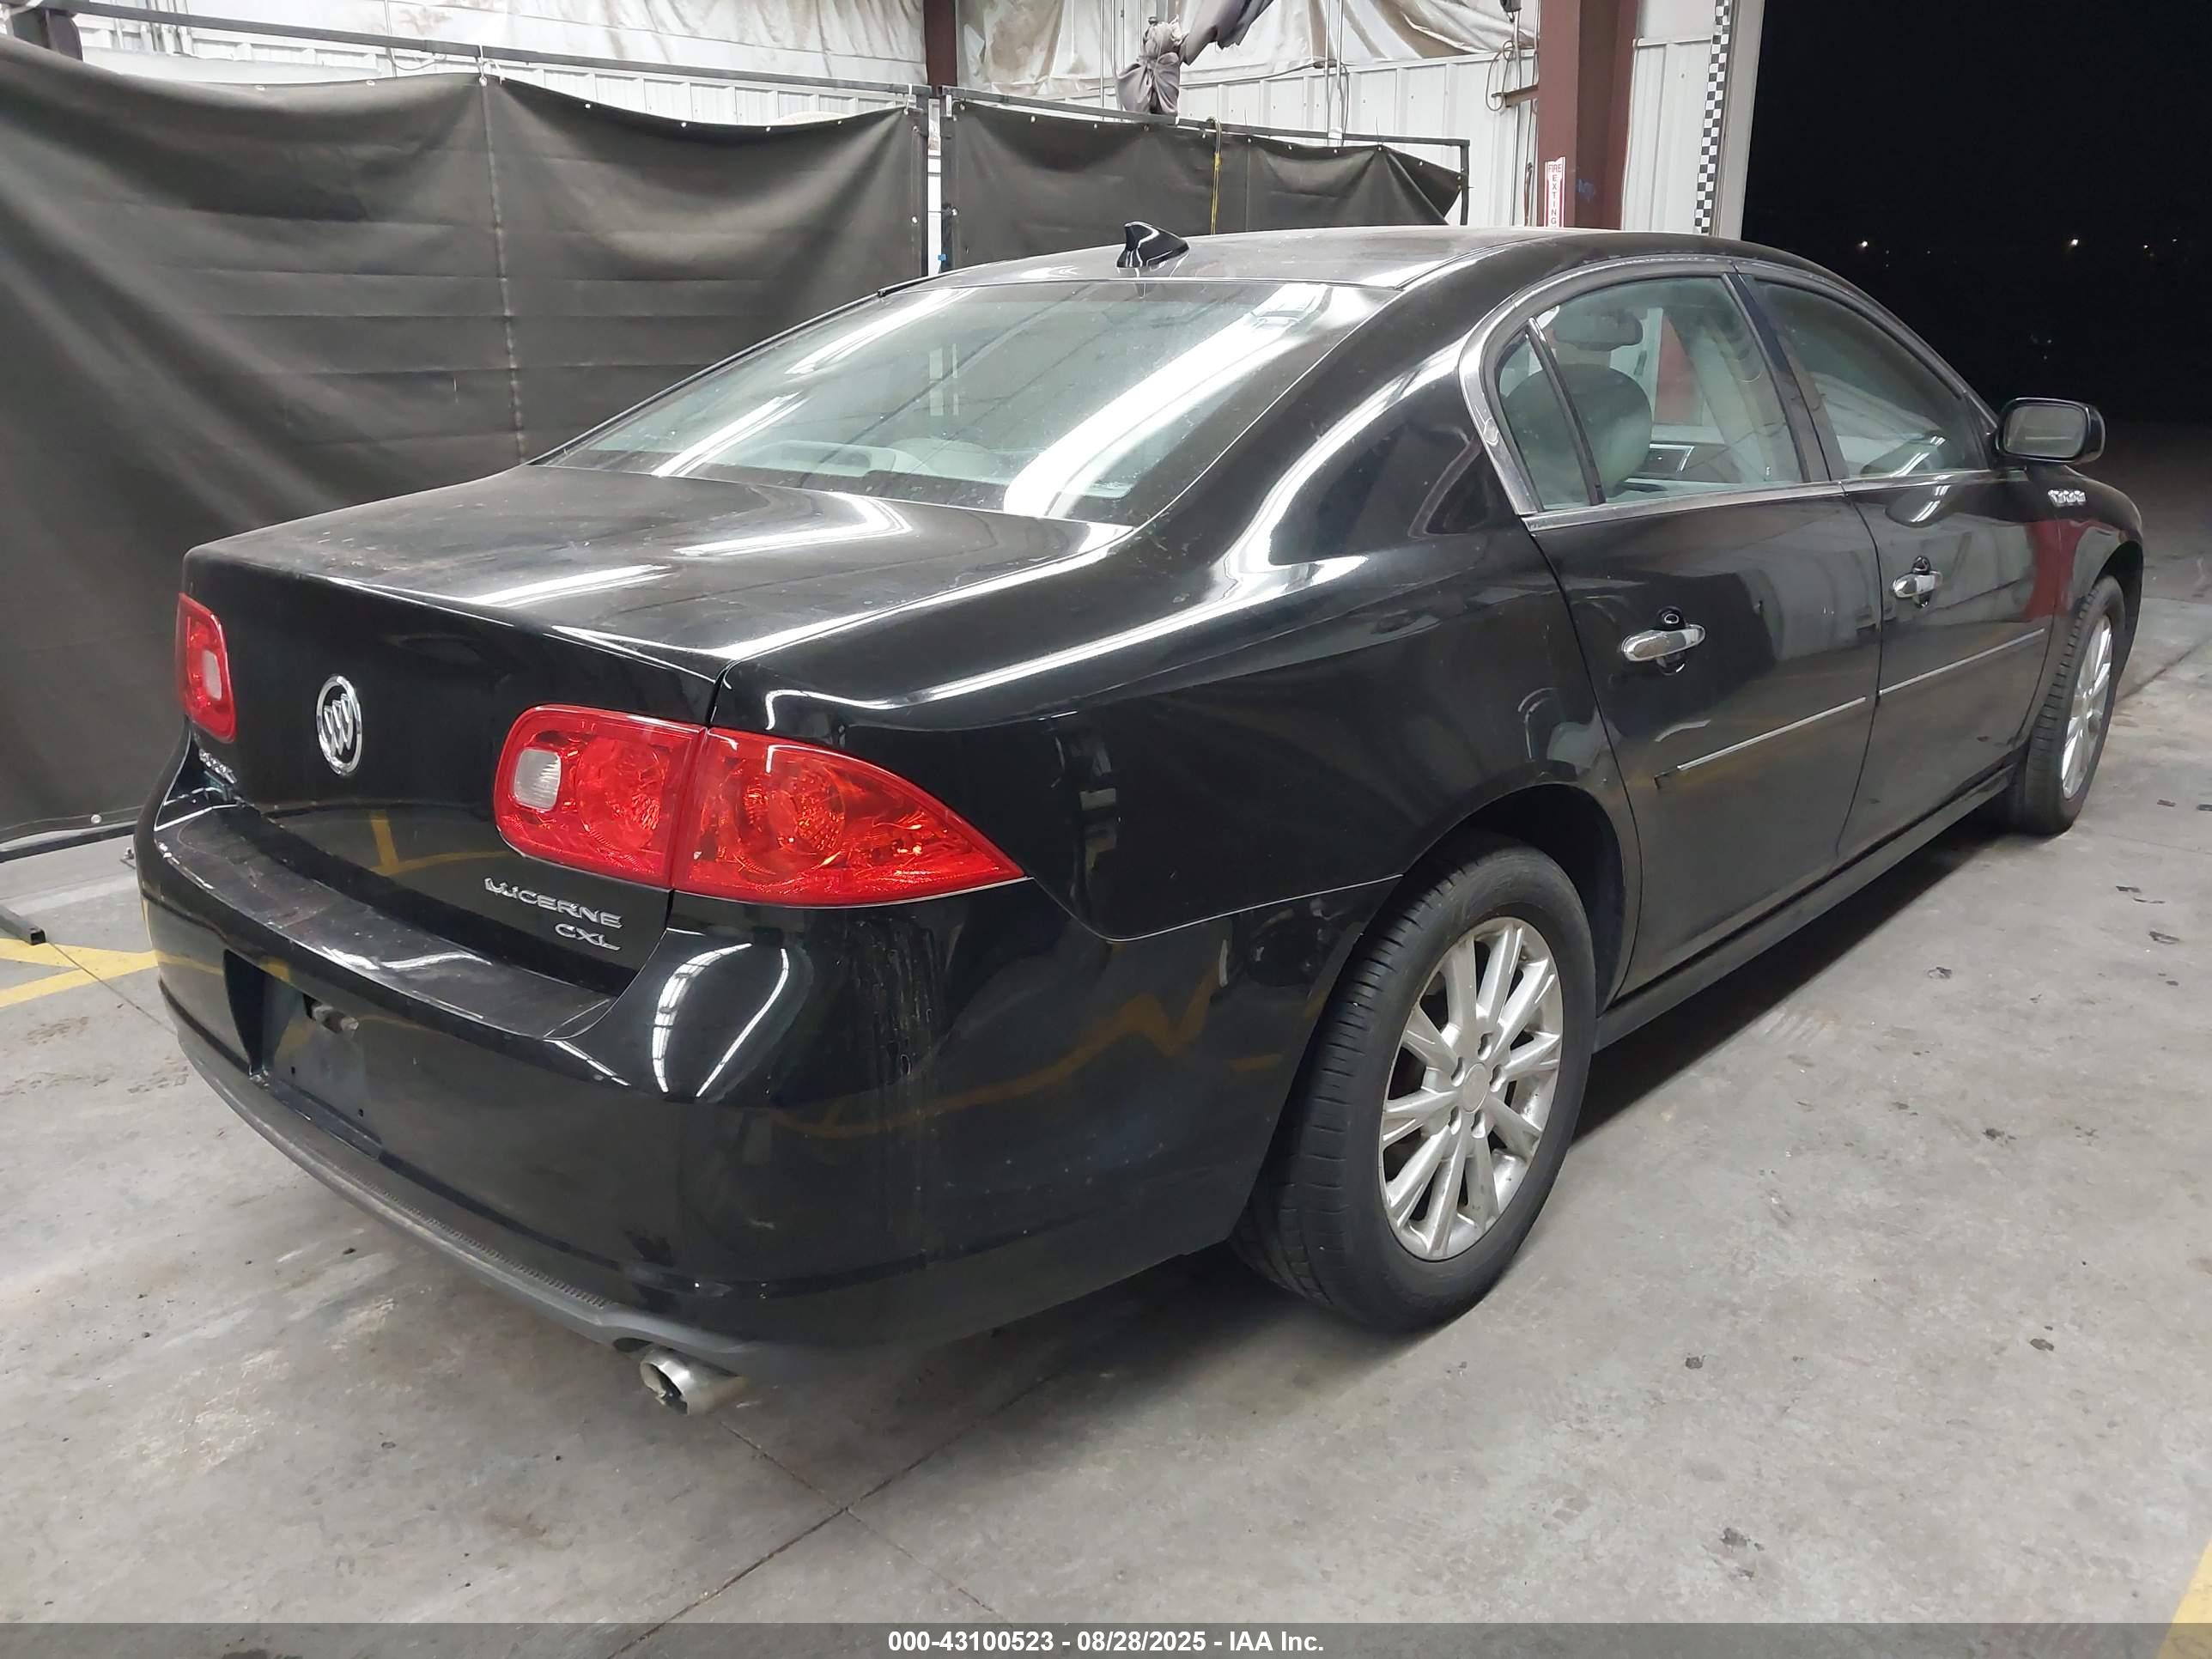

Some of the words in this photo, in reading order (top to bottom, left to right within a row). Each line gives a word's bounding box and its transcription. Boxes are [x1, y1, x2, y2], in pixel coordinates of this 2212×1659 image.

[1548, 163, 1562, 173] FIRE
[484, 877, 623, 929] LUCERNE
[555, 923, 622, 951] CXL
